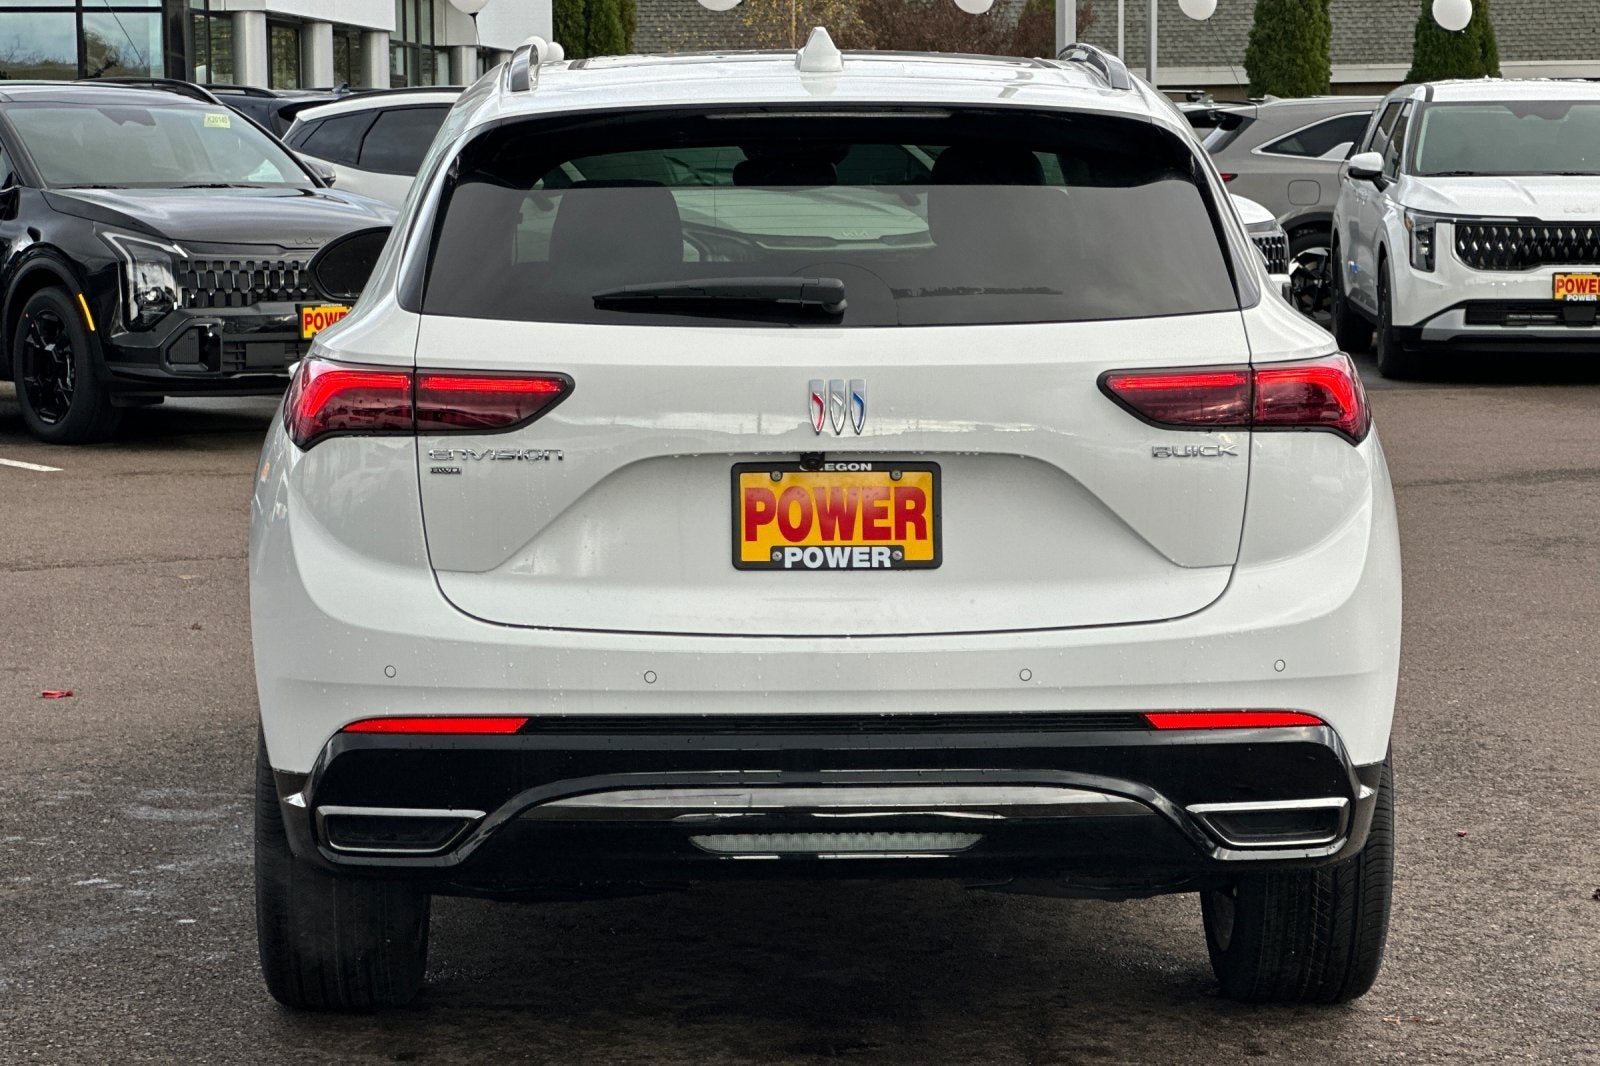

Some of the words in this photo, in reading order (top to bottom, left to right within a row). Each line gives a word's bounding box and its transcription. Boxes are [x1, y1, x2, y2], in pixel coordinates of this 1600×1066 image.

[1566, 294, 1597, 302] POWER
[304, 311, 348, 332] POW
[1151, 444, 1239, 459] BUICK
[799, 462, 872, 472] EGON
[744, 485, 928, 543] POWER
[784, 546, 892, 569] POWER
